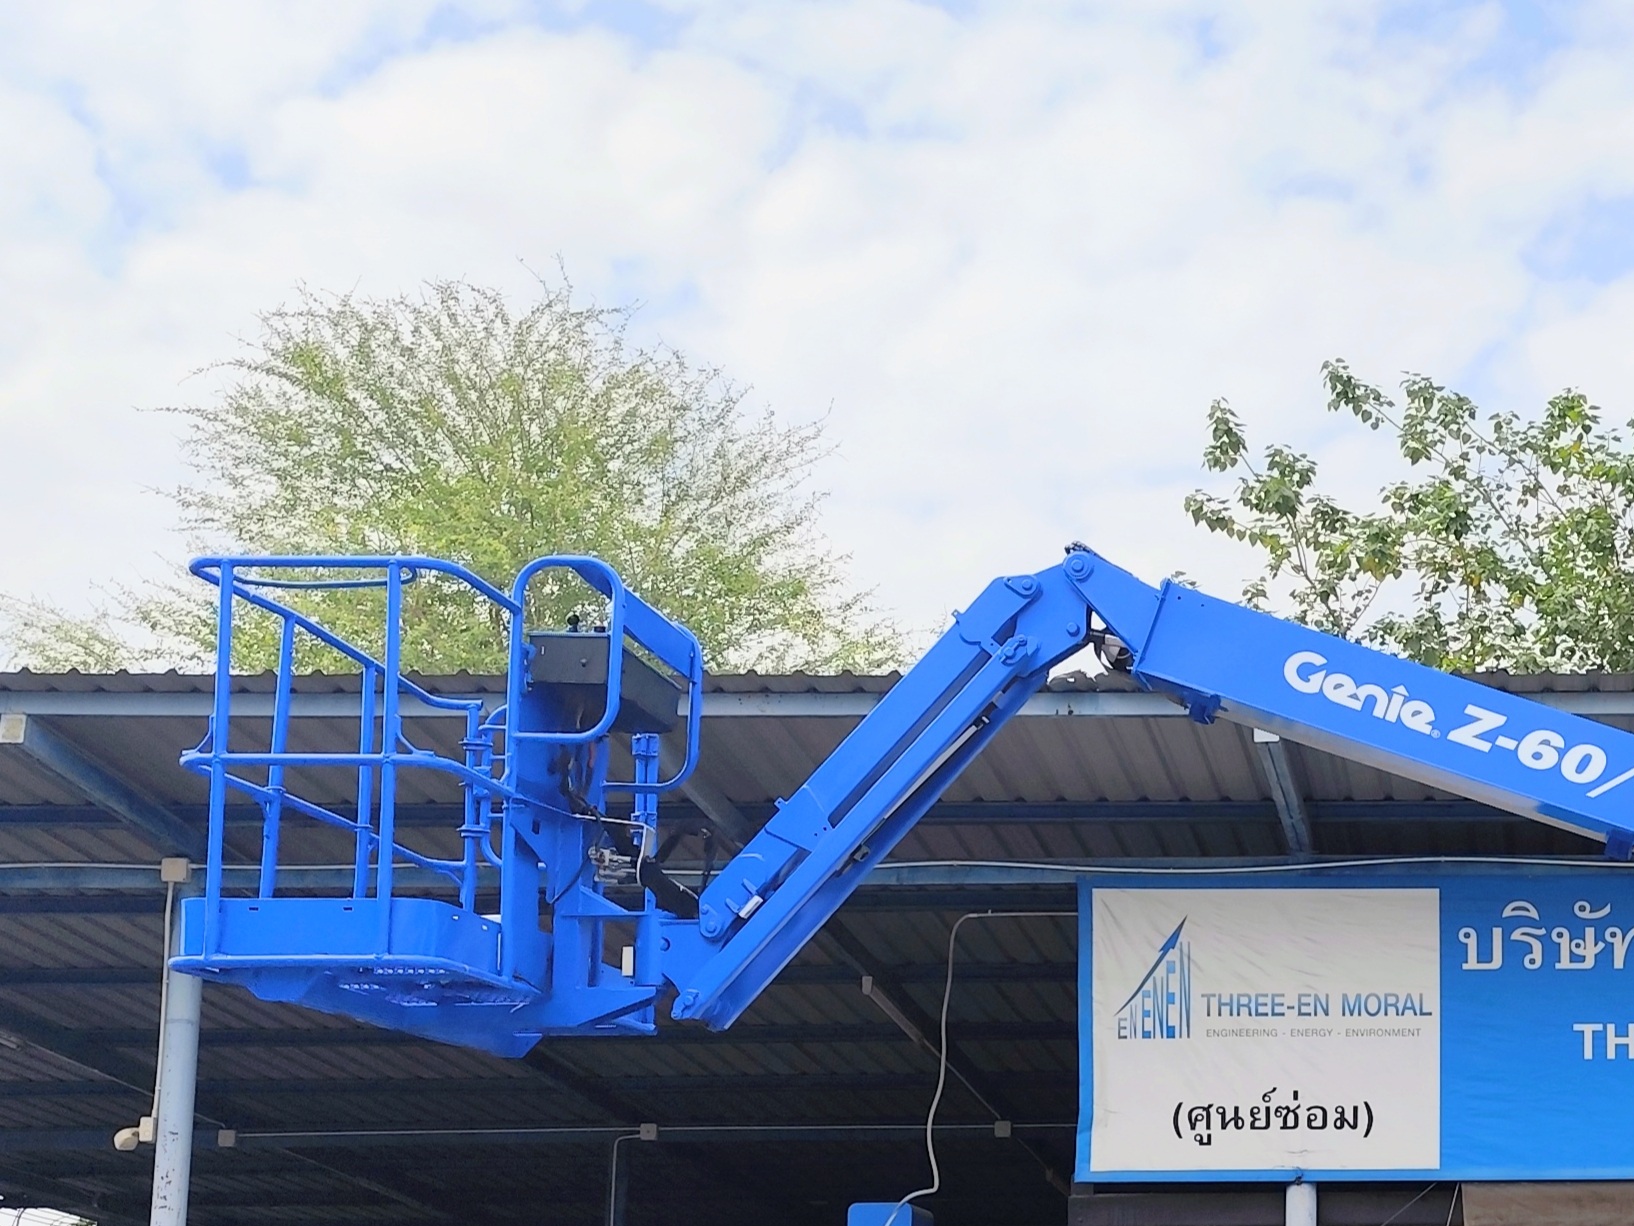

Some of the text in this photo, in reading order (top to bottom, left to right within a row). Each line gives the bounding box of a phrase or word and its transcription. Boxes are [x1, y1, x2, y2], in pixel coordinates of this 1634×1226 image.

[1200, 992, 1433, 1017] THREE-EN MORAL
[1206, 1028, 1278, 1038] ENGINEERING
[1290, 1028, 1333, 1038] ENERGY
[1345, 1028, 1422, 1038] ENVIRONMENT
[1172, 1087, 1374, 1146] (ศูนย์ซ่อม)
